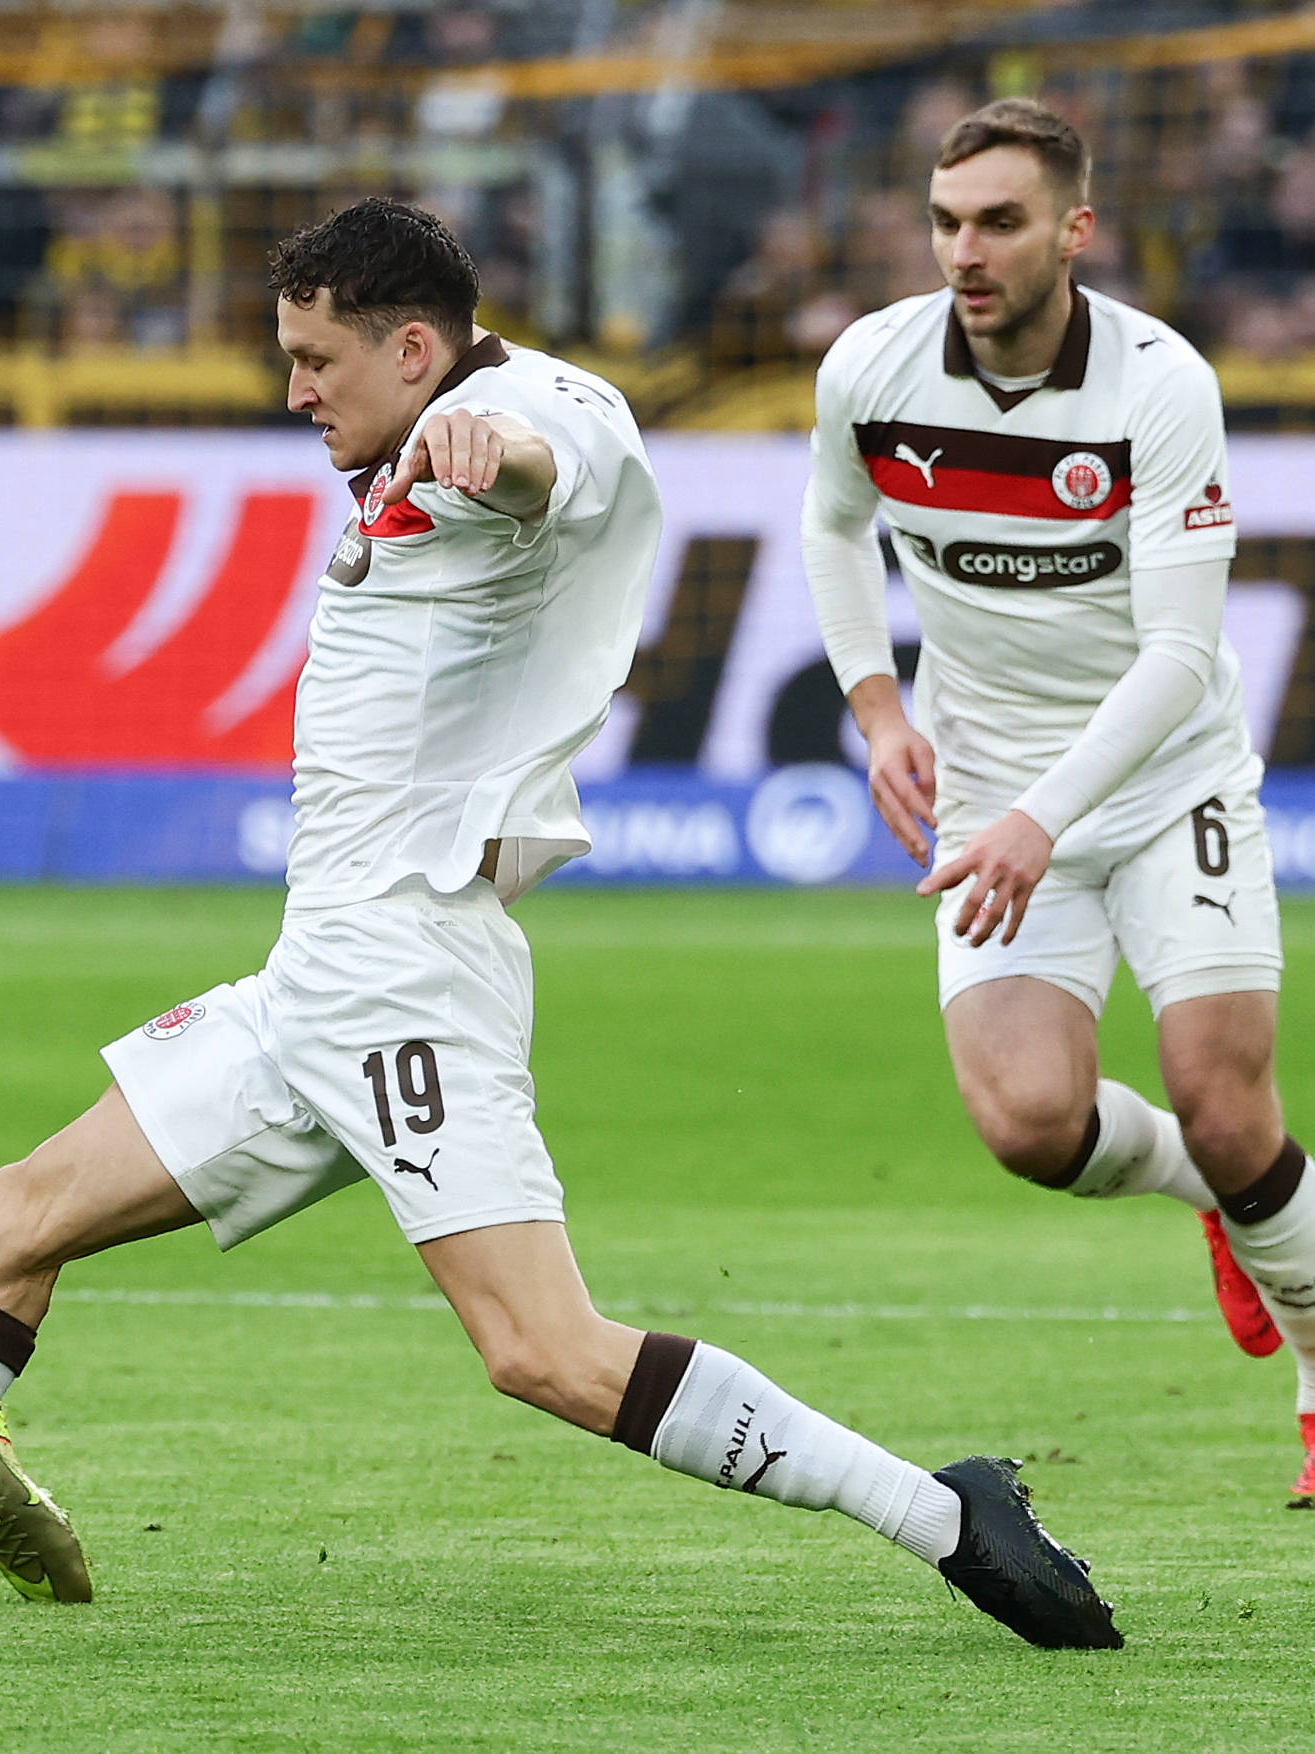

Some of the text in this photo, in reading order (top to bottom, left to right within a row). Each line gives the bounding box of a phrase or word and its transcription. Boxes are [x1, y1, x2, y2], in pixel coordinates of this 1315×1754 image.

[957, 550, 1104, 583] congstar
[1191, 796, 1230, 877] 6
[362, 1040, 445, 1148] 19
